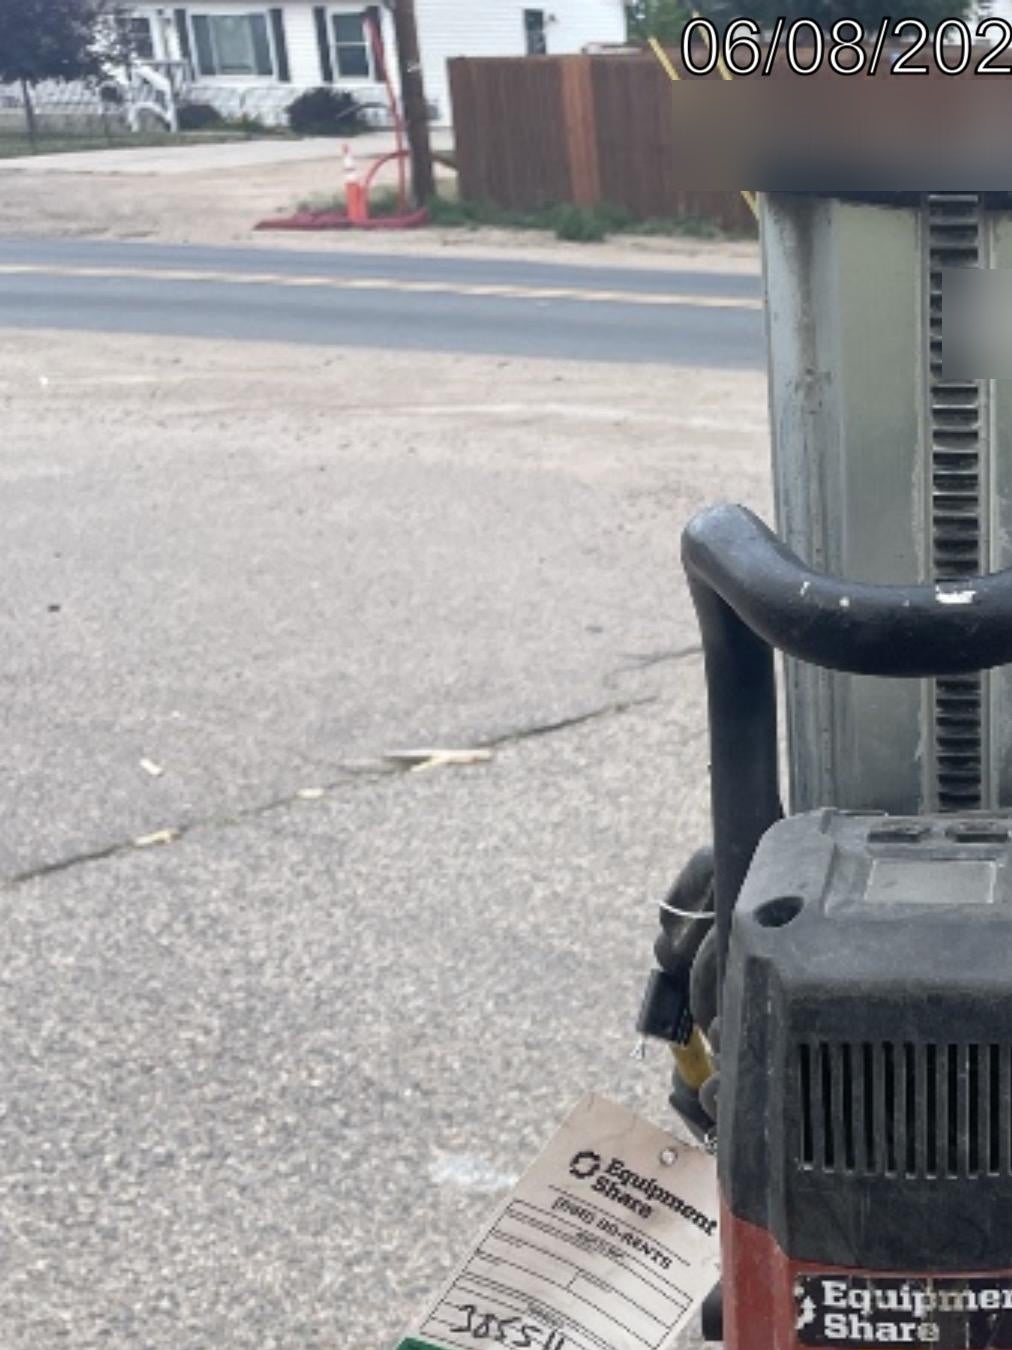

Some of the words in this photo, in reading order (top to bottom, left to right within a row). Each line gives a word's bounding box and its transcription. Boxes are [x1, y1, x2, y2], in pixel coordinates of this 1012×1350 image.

[591, 1175, 652, 1219] Share
[605, 1158, 717, 1236] Equipment
[823, 1313, 940, 1342] Share
